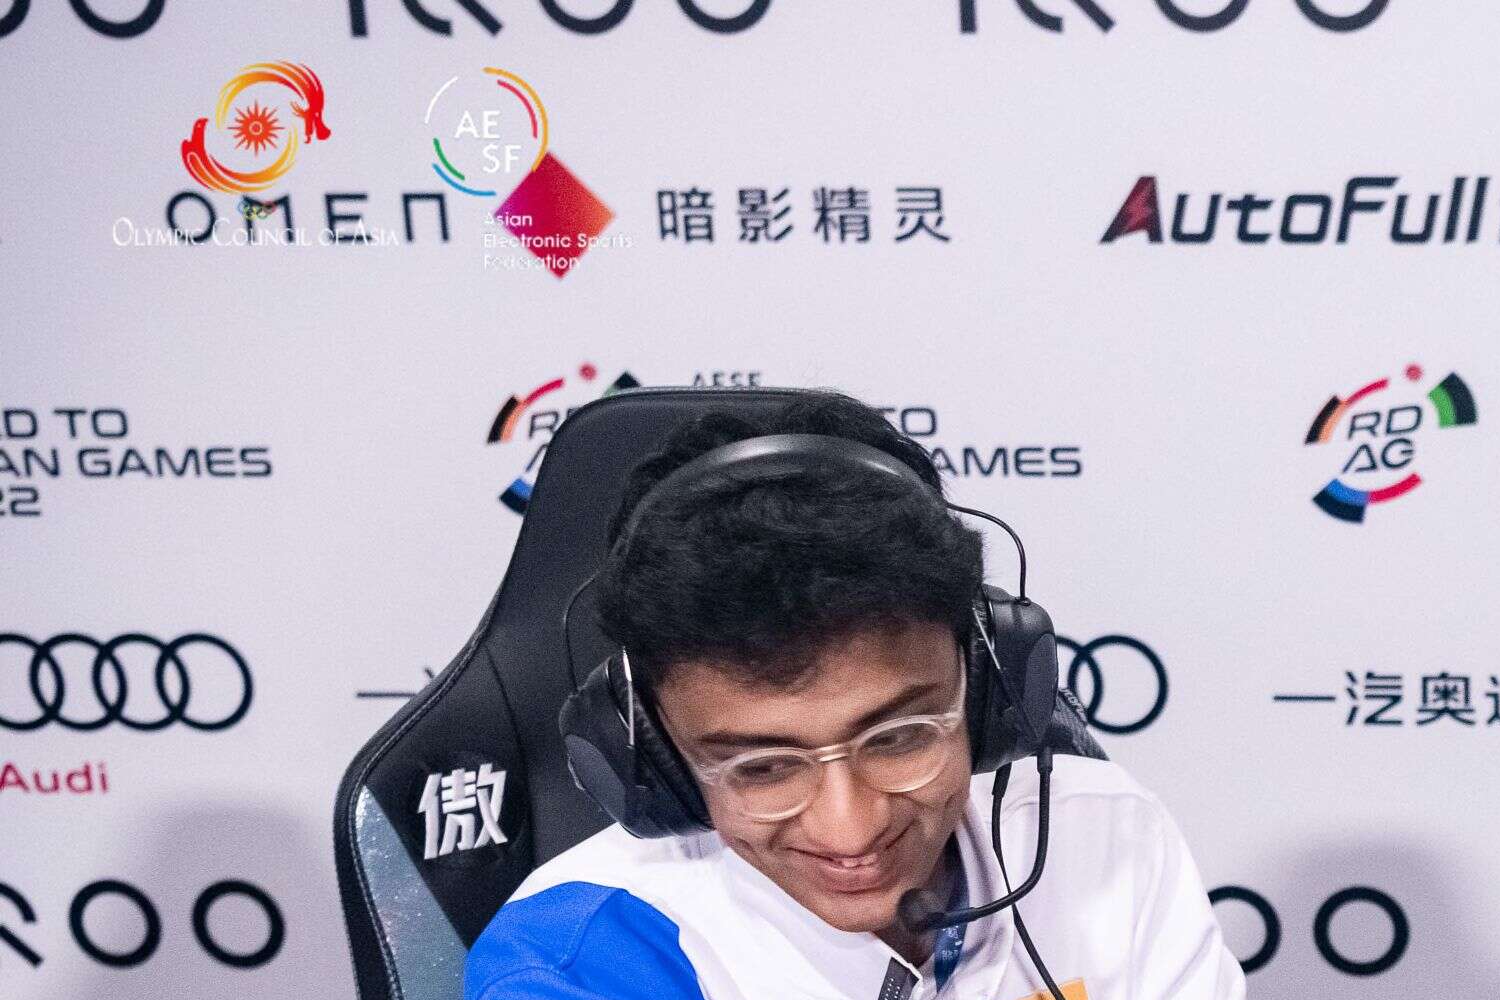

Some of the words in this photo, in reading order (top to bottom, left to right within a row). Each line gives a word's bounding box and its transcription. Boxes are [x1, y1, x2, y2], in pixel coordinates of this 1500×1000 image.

[656, 186, 950, 244] 暗影精灵
[54, 408, 128, 438] TO
[1348, 405, 1422, 439] RD
[77, 447, 273, 478] GAMES
[930, 446, 1082, 477] AMES
[1343, 438, 1416, 473] AG
[0, 762, 109, 793] Audi
[417, 763, 508, 860] 傲
